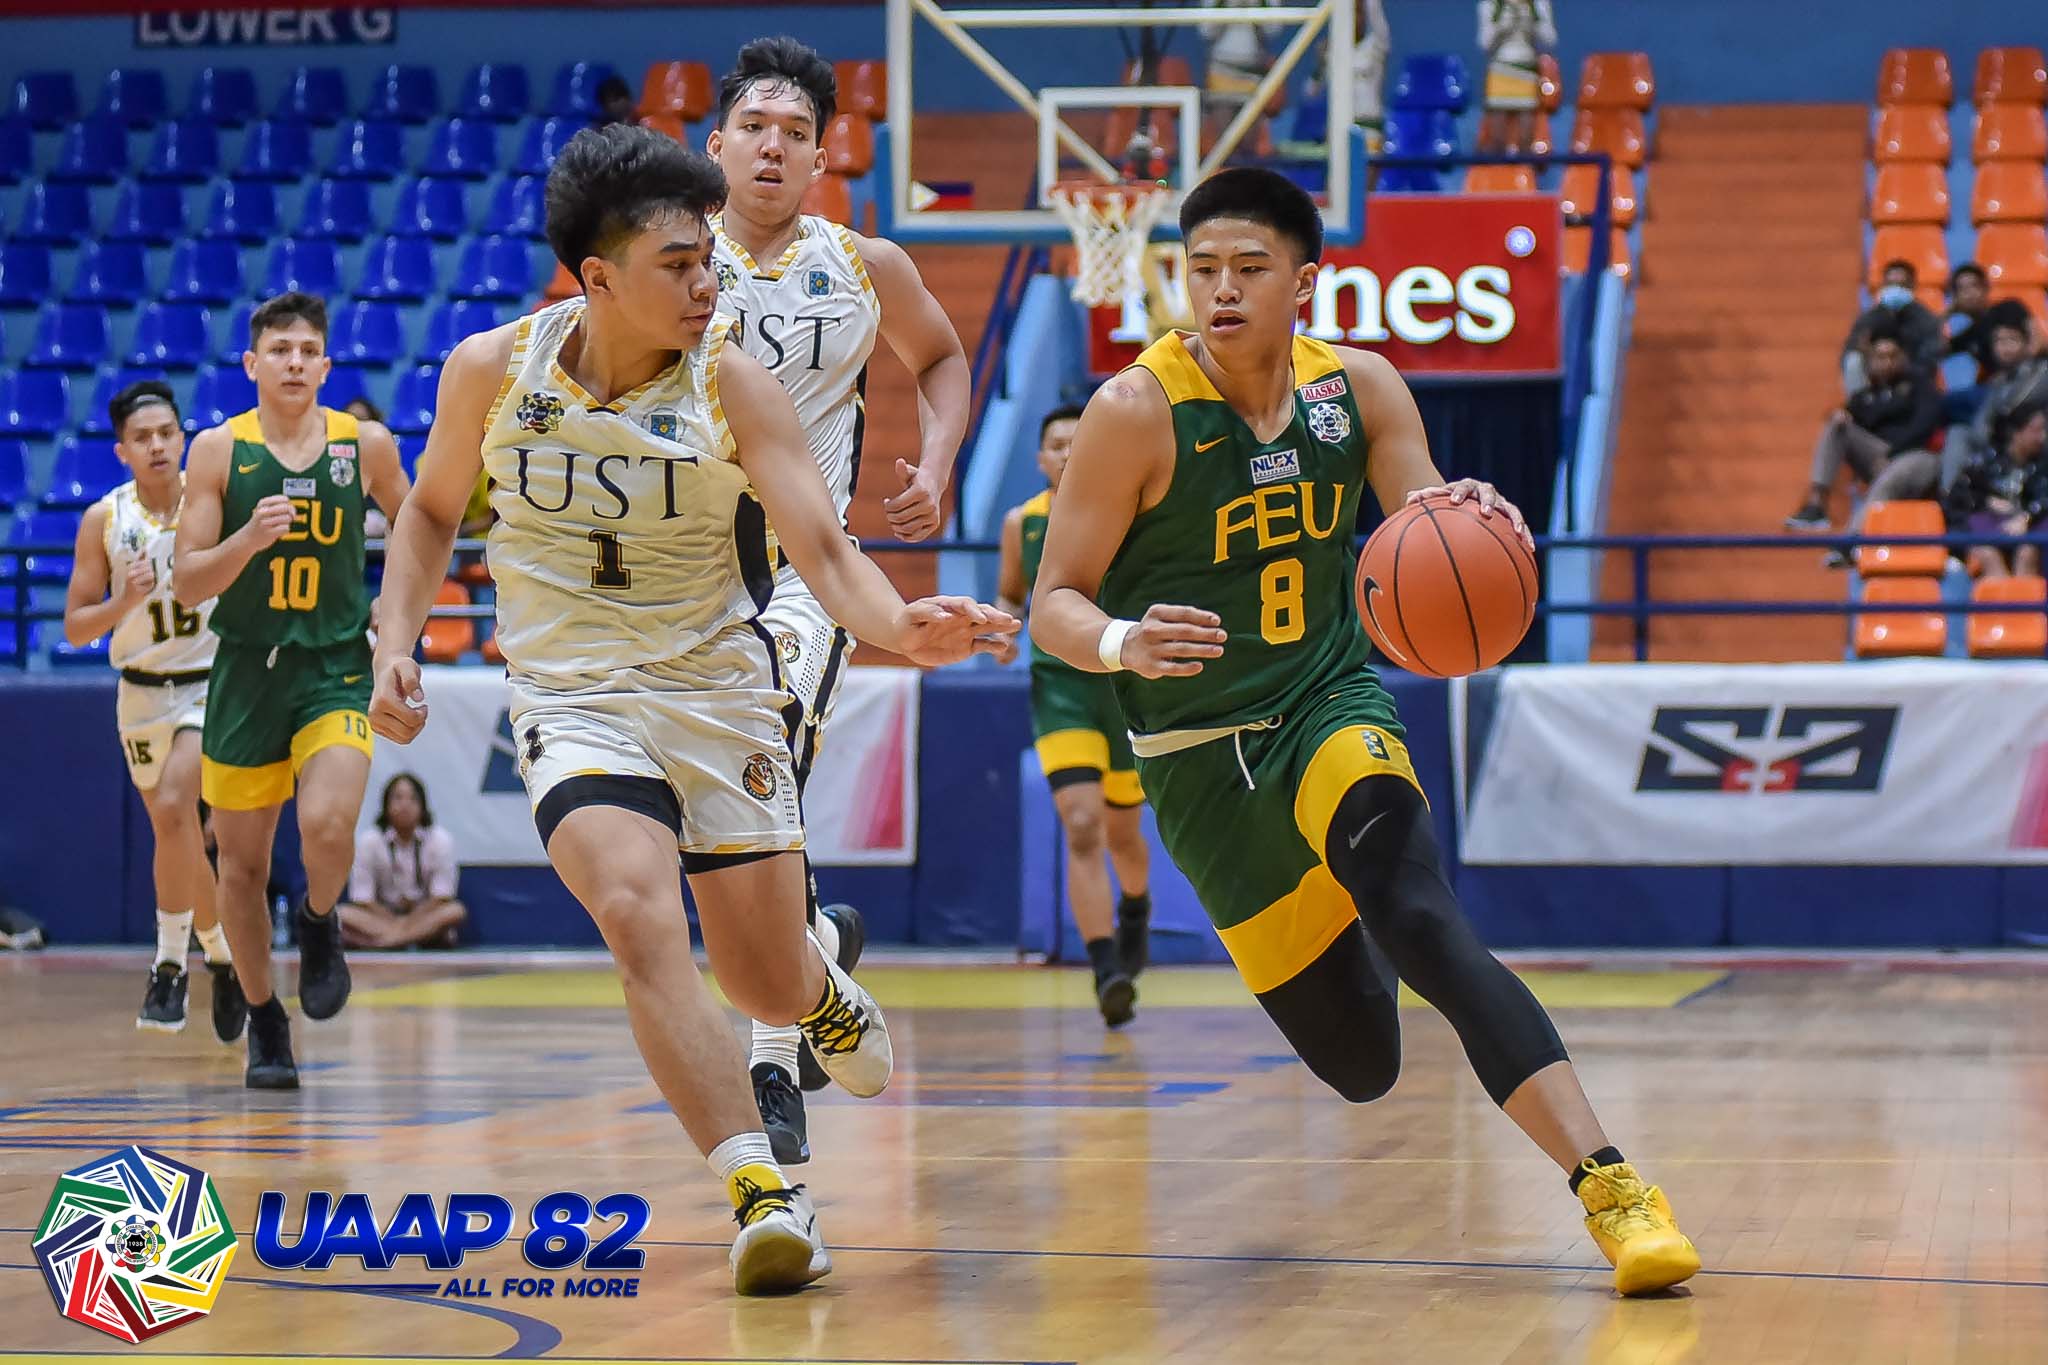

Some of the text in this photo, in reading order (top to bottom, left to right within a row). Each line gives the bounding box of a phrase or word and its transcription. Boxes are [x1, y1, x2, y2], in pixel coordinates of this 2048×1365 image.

[140, 8, 393, 43] LOWER G
[1304, 382, 1341, 399] ALASKA
[513, 447, 699, 521] UST
[1252, 452, 1295, 473] NLEX
[277, 498, 344, 545] EU
[1213, 482, 1345, 564] FEU
[588, 529, 632, 590] 1
[268, 556, 321, 611] 10
[1260, 558, 1306, 645] 8
[345, 714, 367, 741] 10
[127, 738, 152, 767] 15
